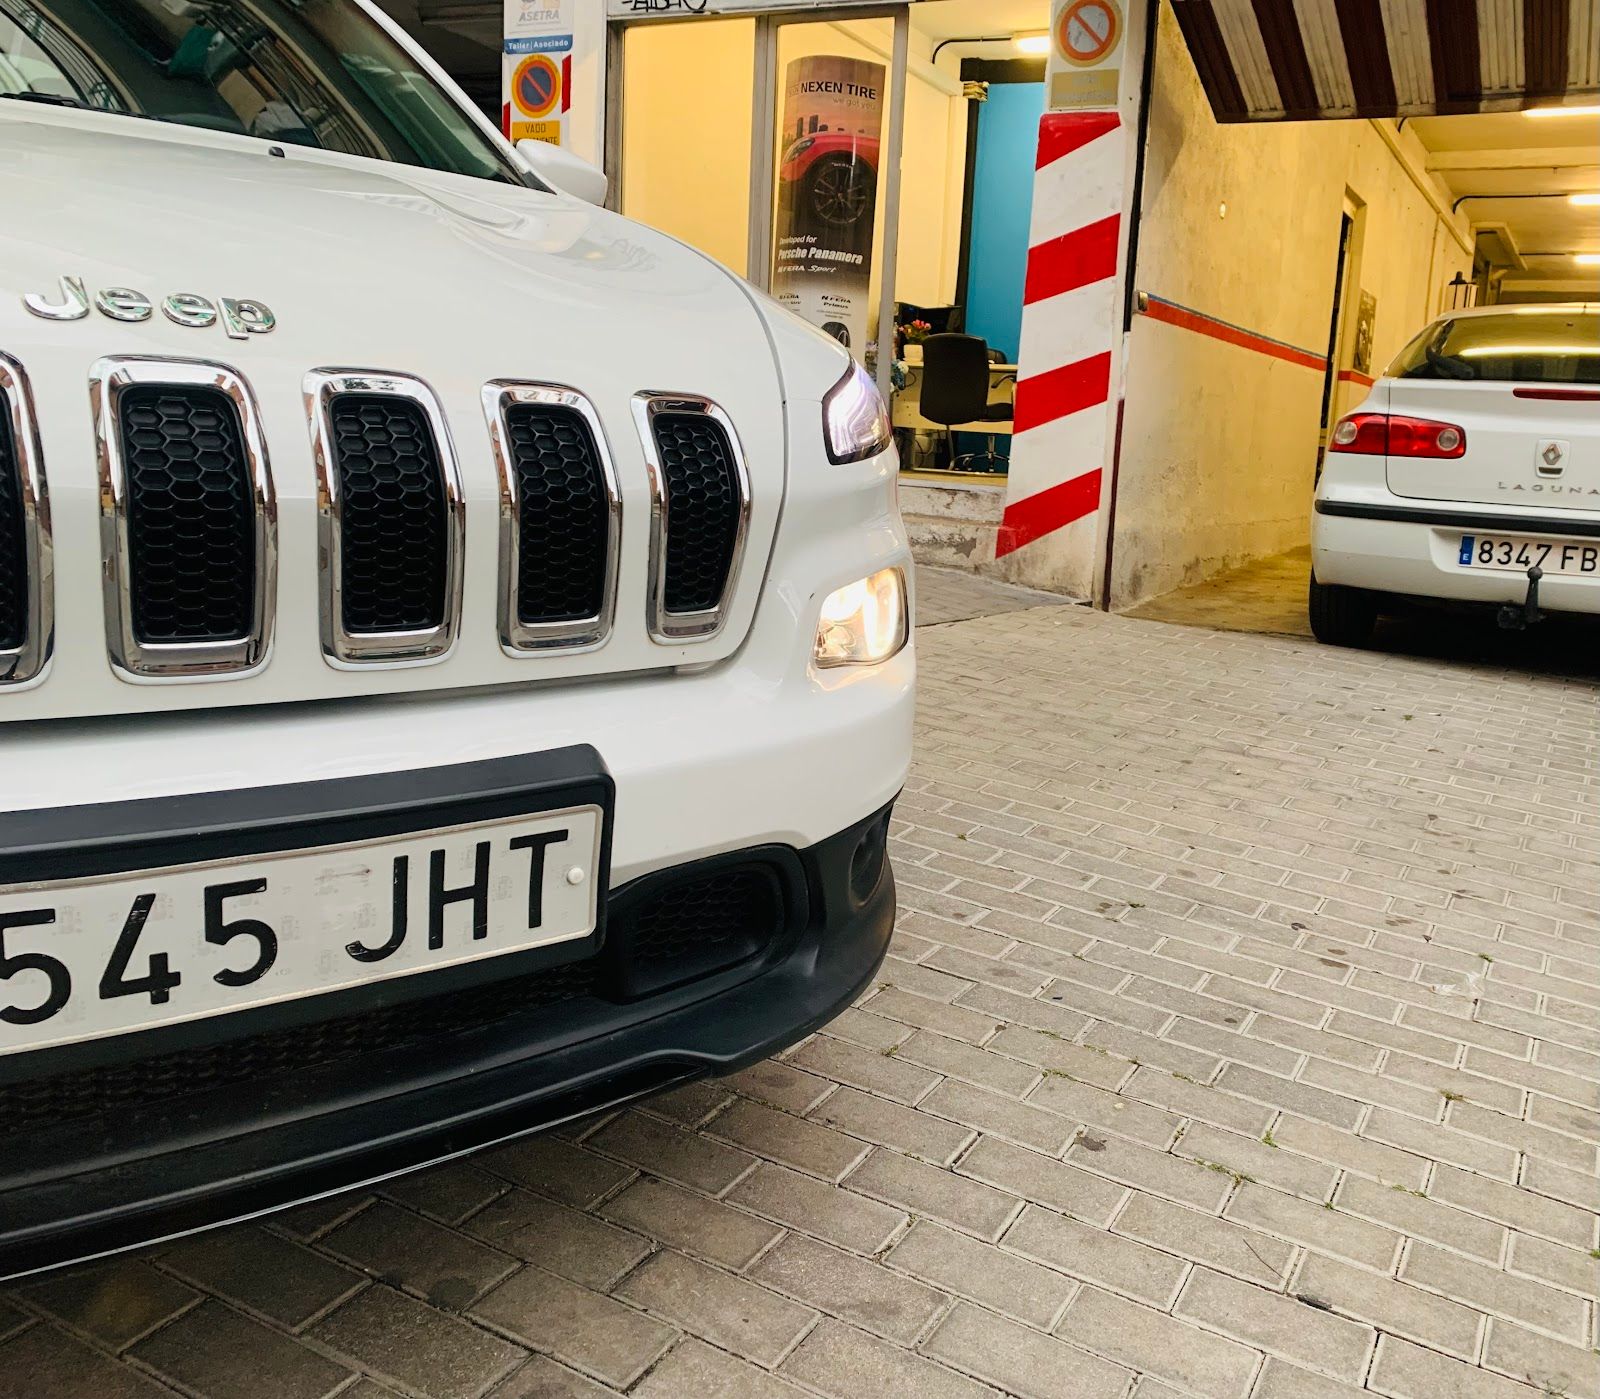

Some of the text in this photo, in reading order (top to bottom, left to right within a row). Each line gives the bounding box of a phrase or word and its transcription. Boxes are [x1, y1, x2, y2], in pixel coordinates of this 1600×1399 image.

[518, 10, 560, 22] ASETRA
[533, 39, 569, 48] Asociado
[801, 81, 877, 100] NEXEN TIRE
[525, 122, 547, 134] VADO
[806, 234, 818, 243] for
[778, 247, 864, 265] Porsche Panamera
[807, 265, 838, 273] Sport
[23, 275, 276, 340] Jeep
[1498, 481, 1600, 496] LAGUNA
[1462, 553, 1469, 561] E
[1478, 540, 1553, 567] 8347
[344, 829, 569, 963] JHT
